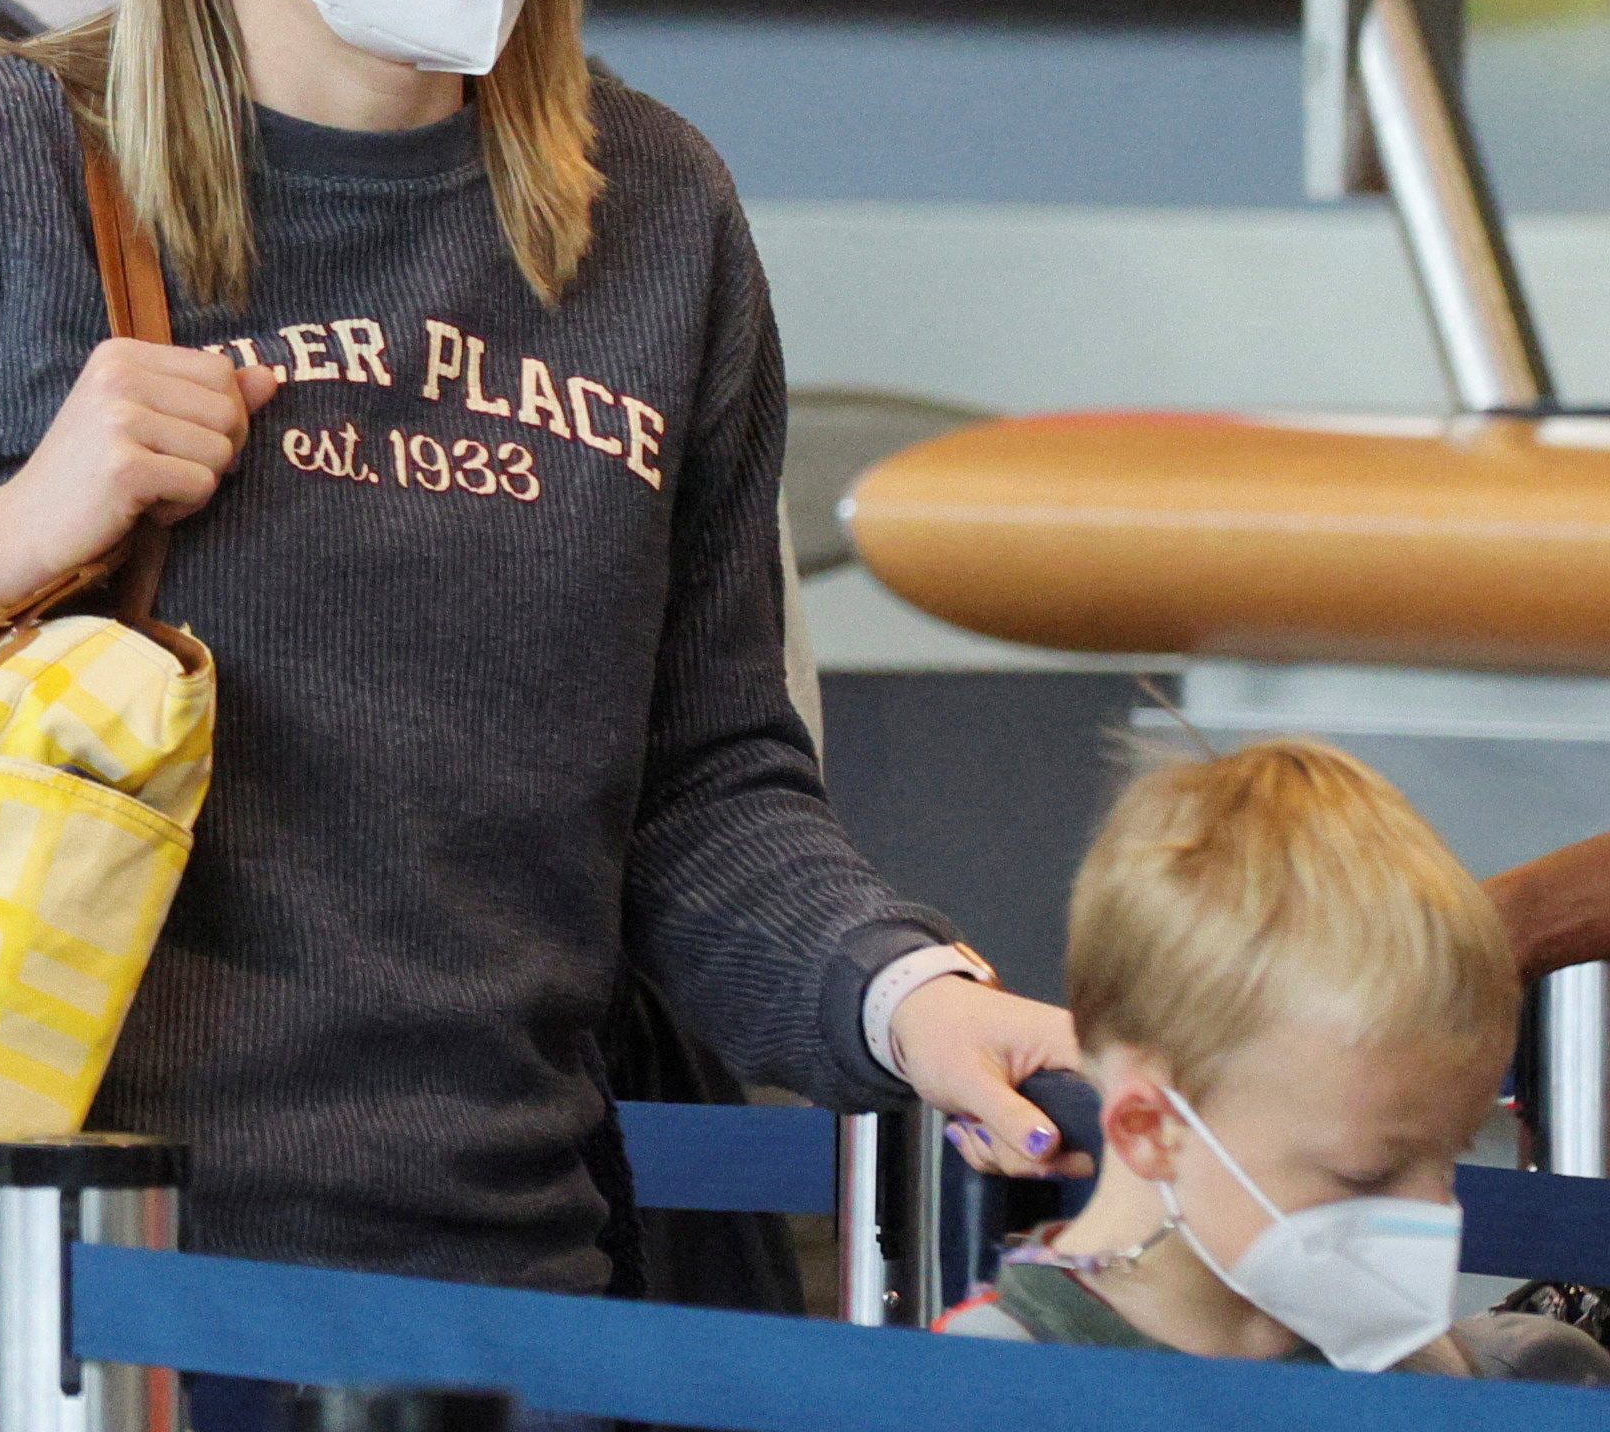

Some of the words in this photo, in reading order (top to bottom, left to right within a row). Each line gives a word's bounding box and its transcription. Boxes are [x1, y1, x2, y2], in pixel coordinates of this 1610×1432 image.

[201, 317, 392, 387] LER
[422, 318, 665, 491] PLACE
[282, 421, 380, 485] est.
[388, 428, 541, 502] 1933
